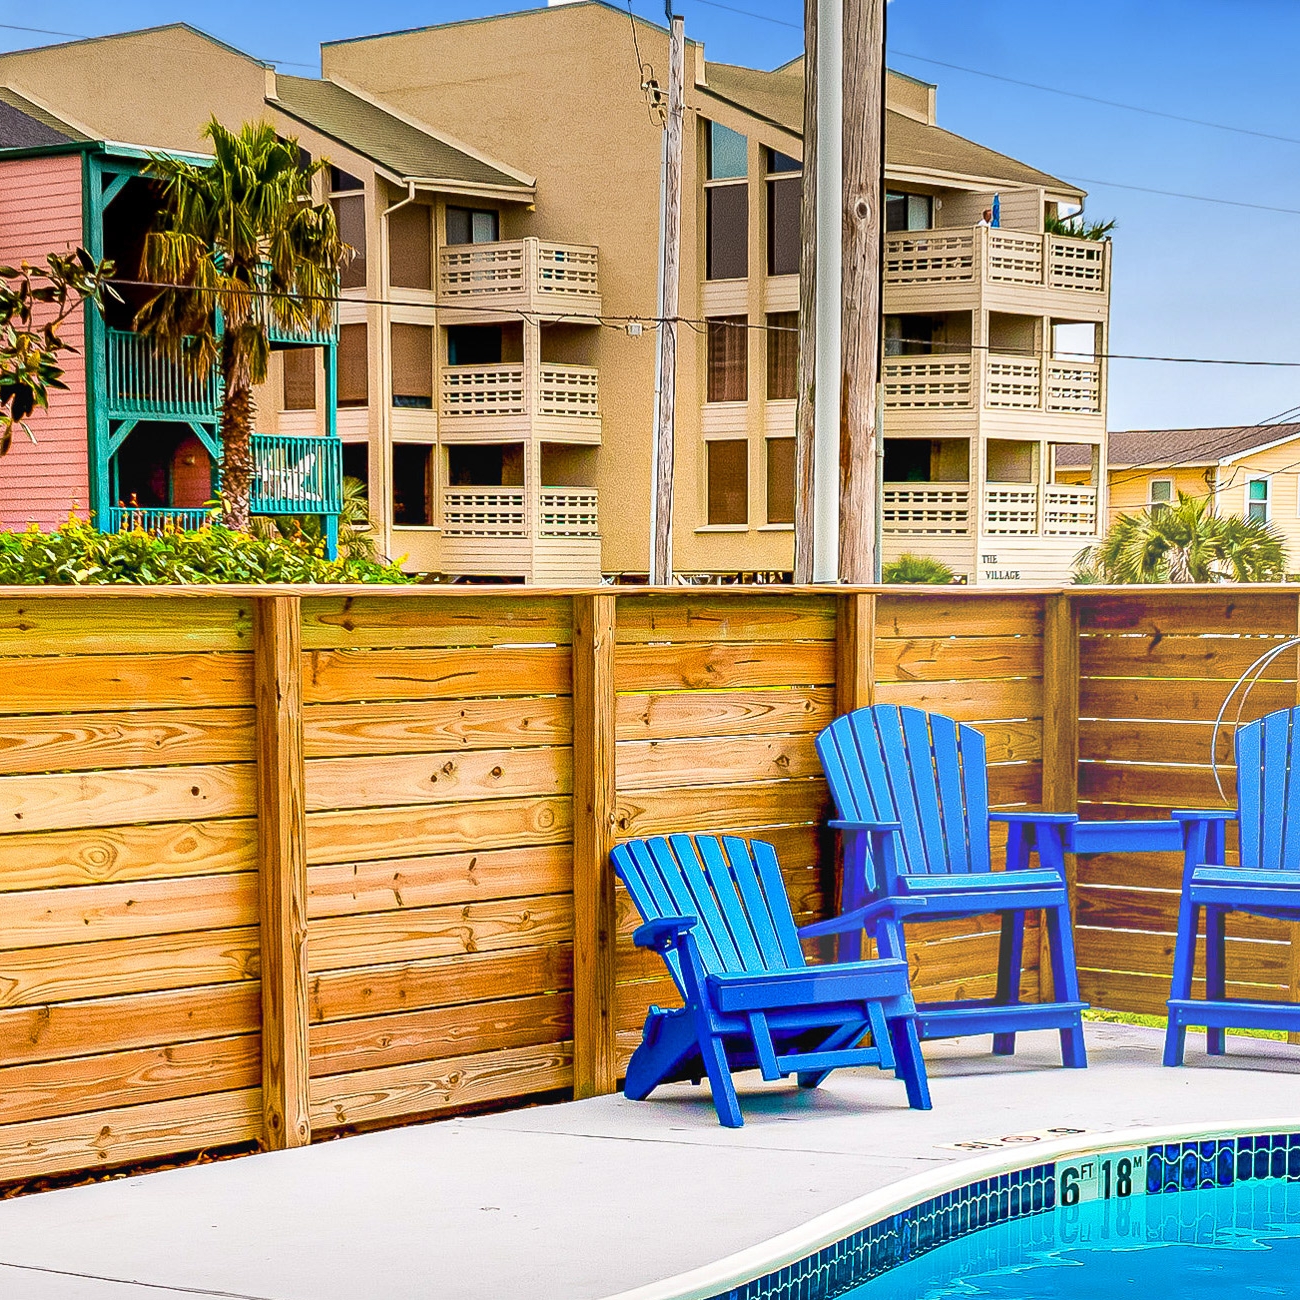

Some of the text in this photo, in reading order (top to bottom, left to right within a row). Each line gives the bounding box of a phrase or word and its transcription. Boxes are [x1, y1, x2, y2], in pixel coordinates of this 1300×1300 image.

[982, 554, 998, 564] THE
[985, 570, 1021, 580] VILLAGE
[1060, 1166, 1080, 1207] 6
[1081, 1162, 1094, 1180] FT
[1133, 1155, 1143, 1168] M
